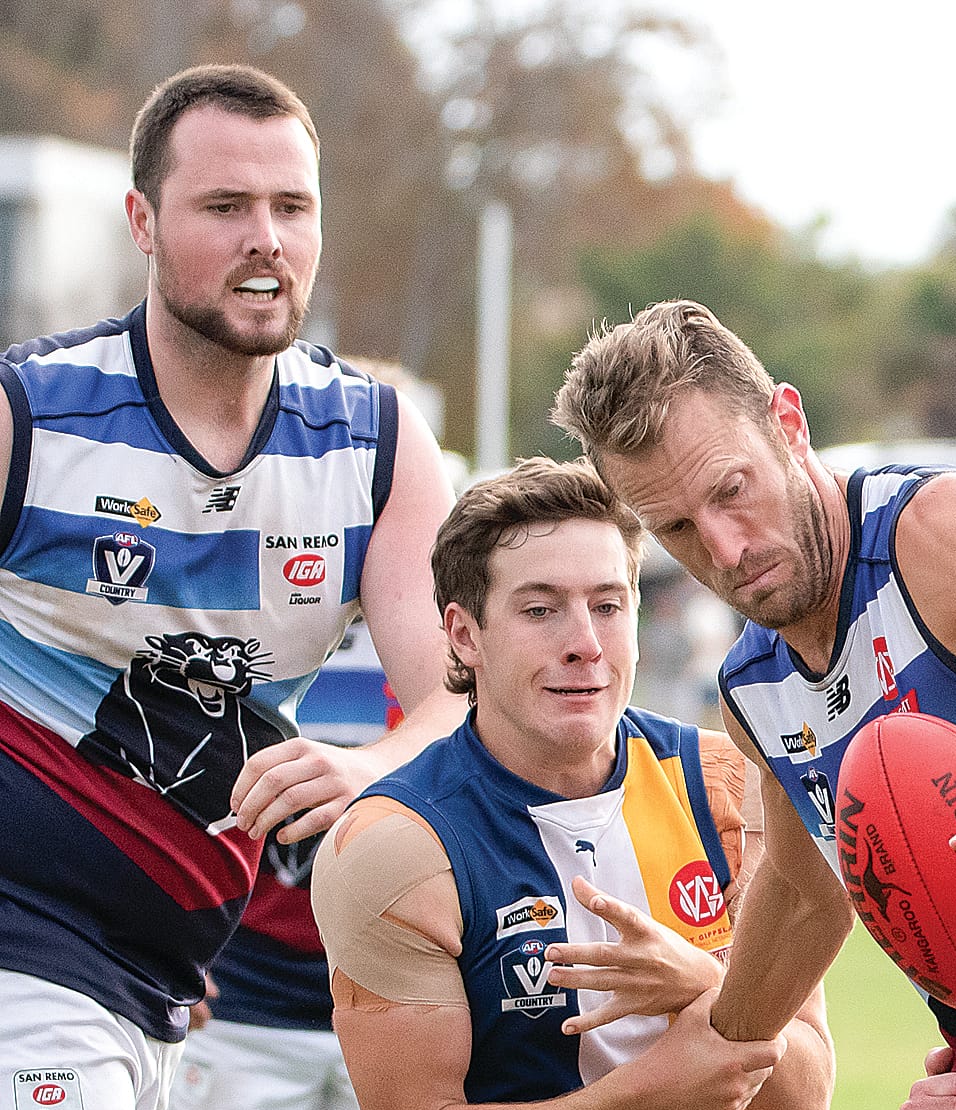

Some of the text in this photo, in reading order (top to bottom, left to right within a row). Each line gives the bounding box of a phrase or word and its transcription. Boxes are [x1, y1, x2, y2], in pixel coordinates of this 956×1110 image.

[115, 532, 138, 546] AFL
[265, 535, 297, 549] SAN
[288, 559, 325, 580] IGA
[100, 584, 136, 598] COUNTRY
[289, 596, 321, 605] LIQUOR
[866, 823, 940, 975] KANGAROO BRAND
[698, 927, 732, 941] GIPPSL
[522, 942, 544, 953] AFL
[515, 996, 554, 1008] COUNTRY
[18, 1072, 75, 1083] SAN REMO
[36, 1087, 63, 1102] IGA
